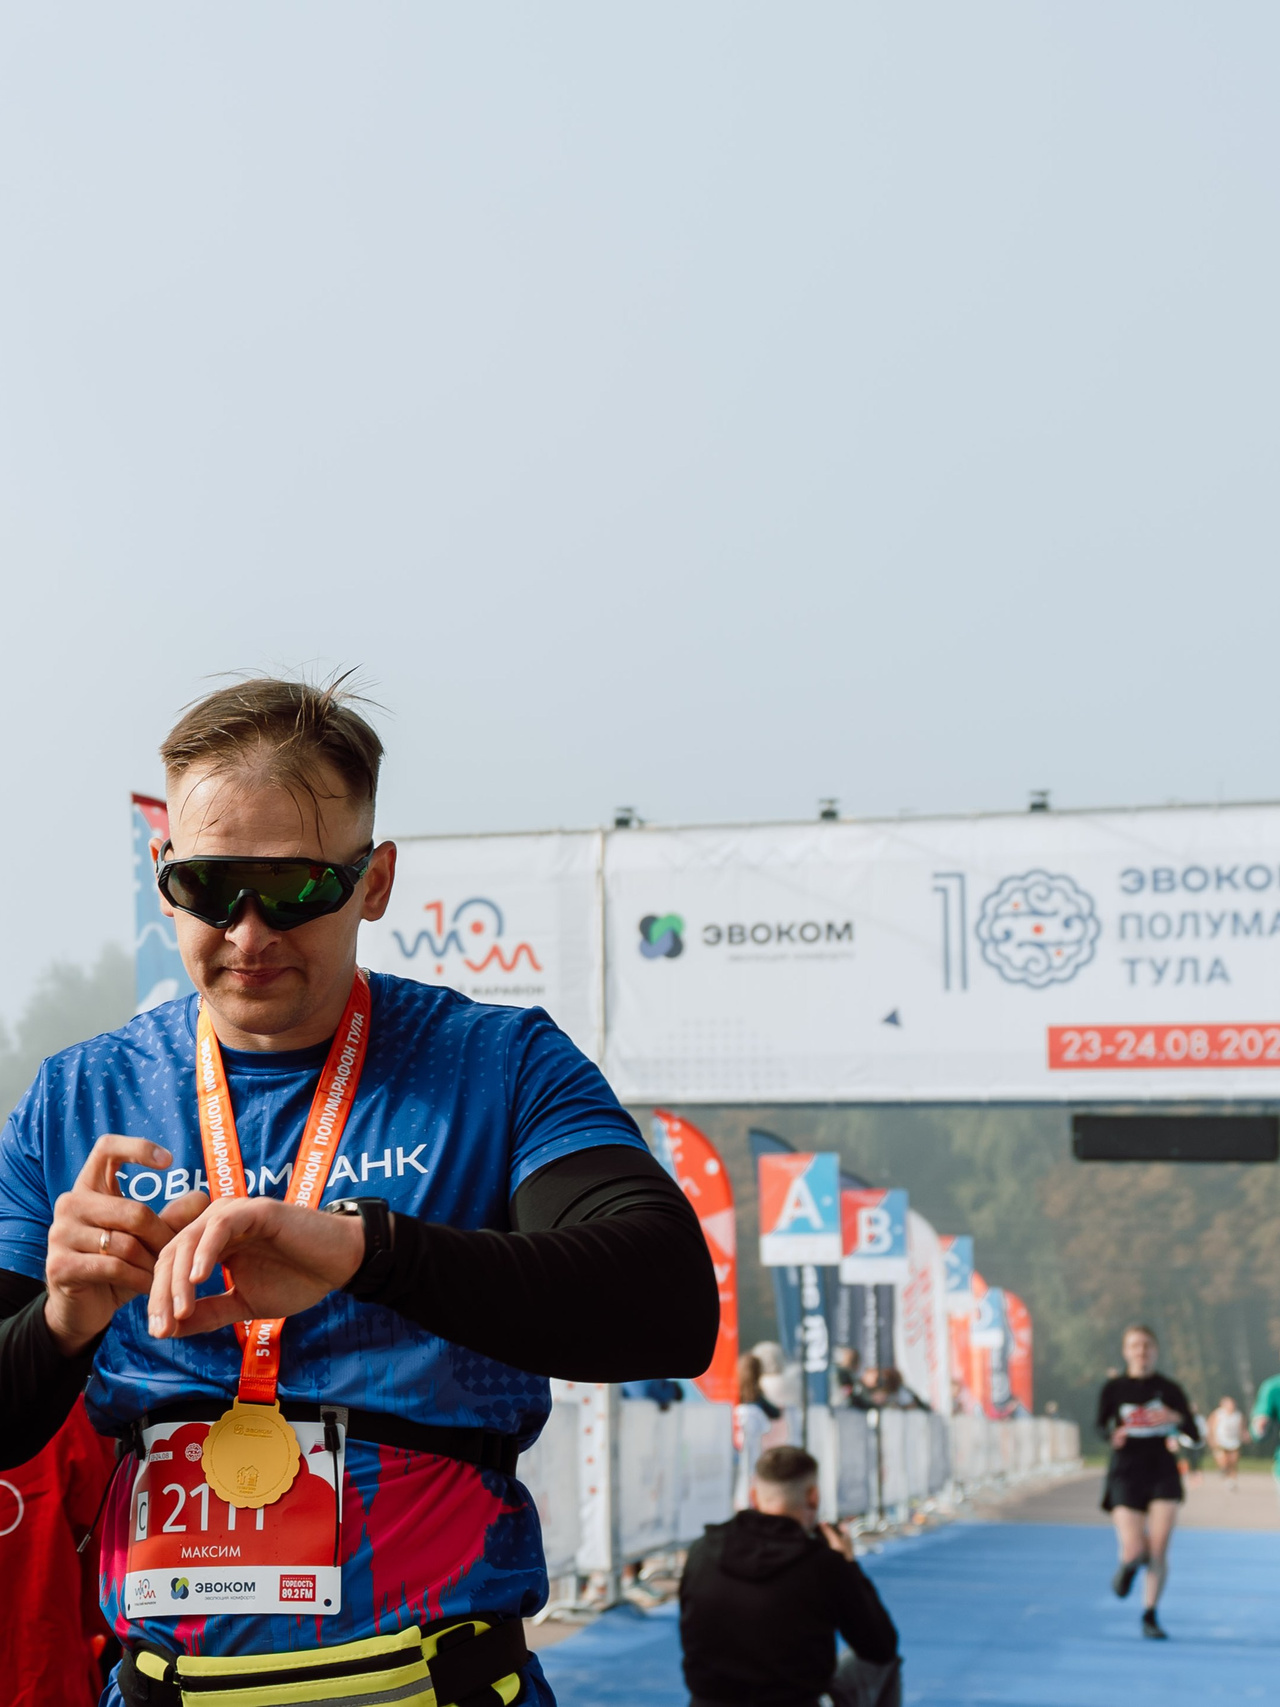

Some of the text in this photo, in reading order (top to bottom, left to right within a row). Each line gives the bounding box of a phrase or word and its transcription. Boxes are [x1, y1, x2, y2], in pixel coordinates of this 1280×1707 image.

[1120, 864, 1280, 895] ЭВОКО
[703, 921, 853, 946] ЭВОКОМ
[1121, 957, 1231, 986] ТУЛА
[294, 1011, 365, 1208] ЭВОКОМ ПОЛУМАРАФОН ТУЛА
[207, 1094, 235, 1198] ПОЛУМАРАФОН
[776, 1178, 823, 1231] A
[858, 1207, 892, 1254] B
[256, 1349, 270, 1357] 5
[181, 1546, 241, 1558] МАКСИМ
[195, 1582, 256, 1593] ЭВОКОМ
[282, 1580, 313, 1588] ГОРДОСТЬ
[282, 1589, 313, 1599] 89.2 FM
